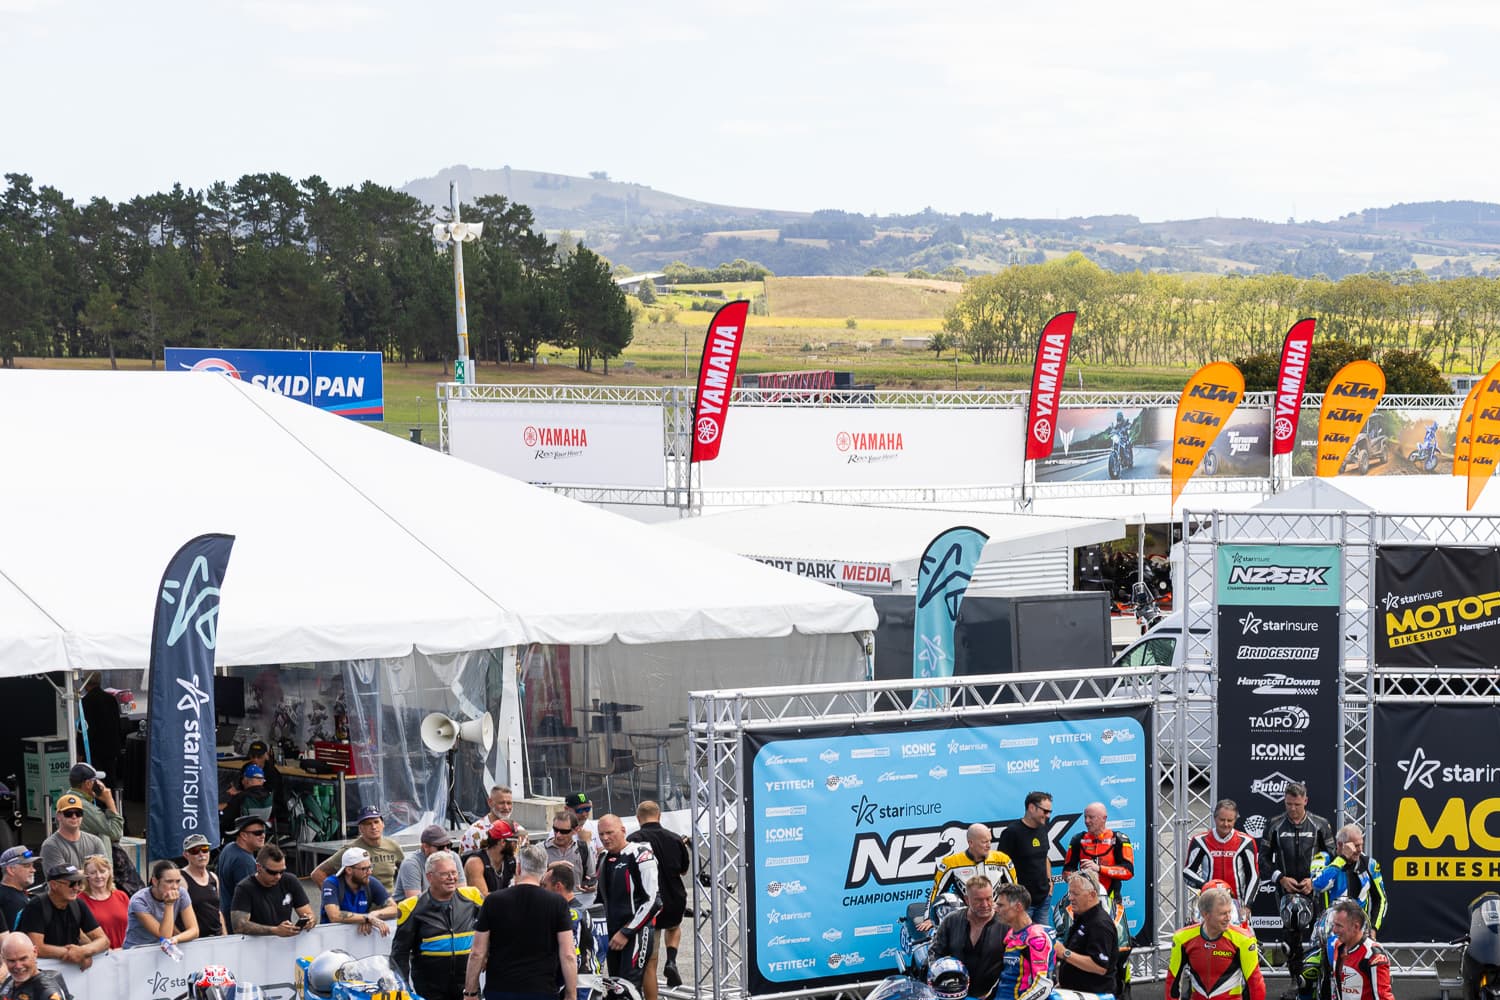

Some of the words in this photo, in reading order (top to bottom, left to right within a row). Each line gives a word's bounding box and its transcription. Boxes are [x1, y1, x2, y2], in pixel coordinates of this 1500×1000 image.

[701, 325, 738, 416] YAMAHA
[1037, 333, 1066, 417] YAMAHA
[1276, 340, 1307, 416] YAMAHA
[316, 377, 366, 398] PAN
[1189, 382, 1238, 404] KTM
[1332, 381, 1379, 400] KTM
[1182, 410, 1221, 428] KTM
[1326, 408, 1364, 424] KTM
[538, 428, 588, 447] YAMAHA
[852, 433, 904, 451] YAMAHA
[1177, 435, 1207, 448] KTM
[1323, 432, 1350, 443] KTM
[1174, 457, 1194, 466] KTM
[1472, 455, 1493, 465] KTM
[797, 562, 837, 579] PARK
[842, 564, 892, 583] MEDIA
[1229, 565, 1332, 586] NZSBK
[1400, 590, 1444, 605] starinsure
[1262, 619, 1319, 631] starinsure
[1459, 619, 1497, 632] Hampton
[1394, 628, 1453, 646] BIKESHOW
[1237, 646, 1320, 660] BRIDGESTONE
[1237, 676, 1285, 687] Hampton
[1285, 677, 1321, 686] Downs
[1049, 733, 1092, 745] YETITECH
[902, 743, 937, 755] ICONIC
[1250, 744, 1306, 757] ICONIC
[1007, 759, 1040, 772] ICONIC
[182, 719, 200, 831] starinsure
[765, 779, 815, 792] YETITECH
[1251, 779, 1290, 794] Putoli
[880, 799, 943, 819] starinsure
[766, 826, 804, 839] ICONIC
[842, 888, 924, 908] CHAMPIONSHIP
[1252, 917, 1283, 927] yclespot
[768, 958, 817, 972] YETITECH
